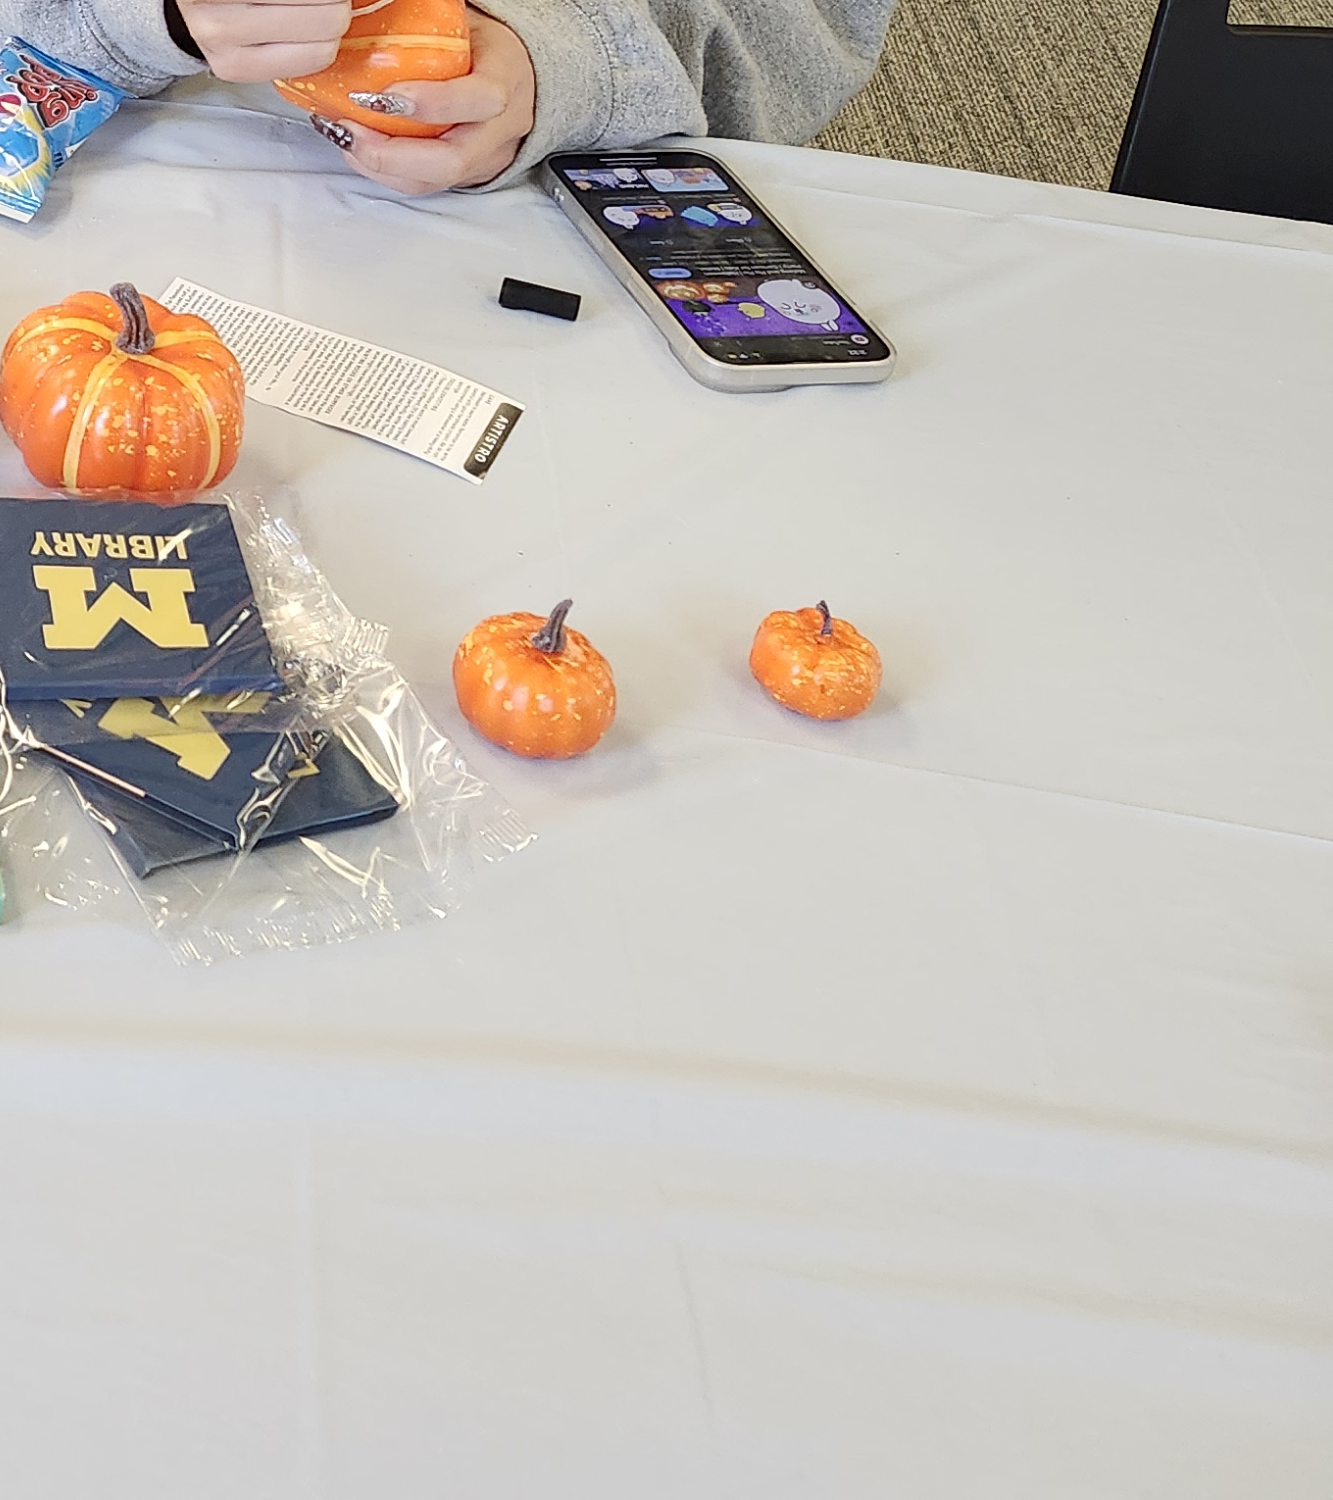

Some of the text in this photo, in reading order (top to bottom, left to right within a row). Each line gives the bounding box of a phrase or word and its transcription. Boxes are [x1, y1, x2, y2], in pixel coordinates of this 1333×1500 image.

[474, 414, 511, 464] ARTISTRO
[31, 531, 188, 560] LIBRARY
[33, 565, 210, 650] M
